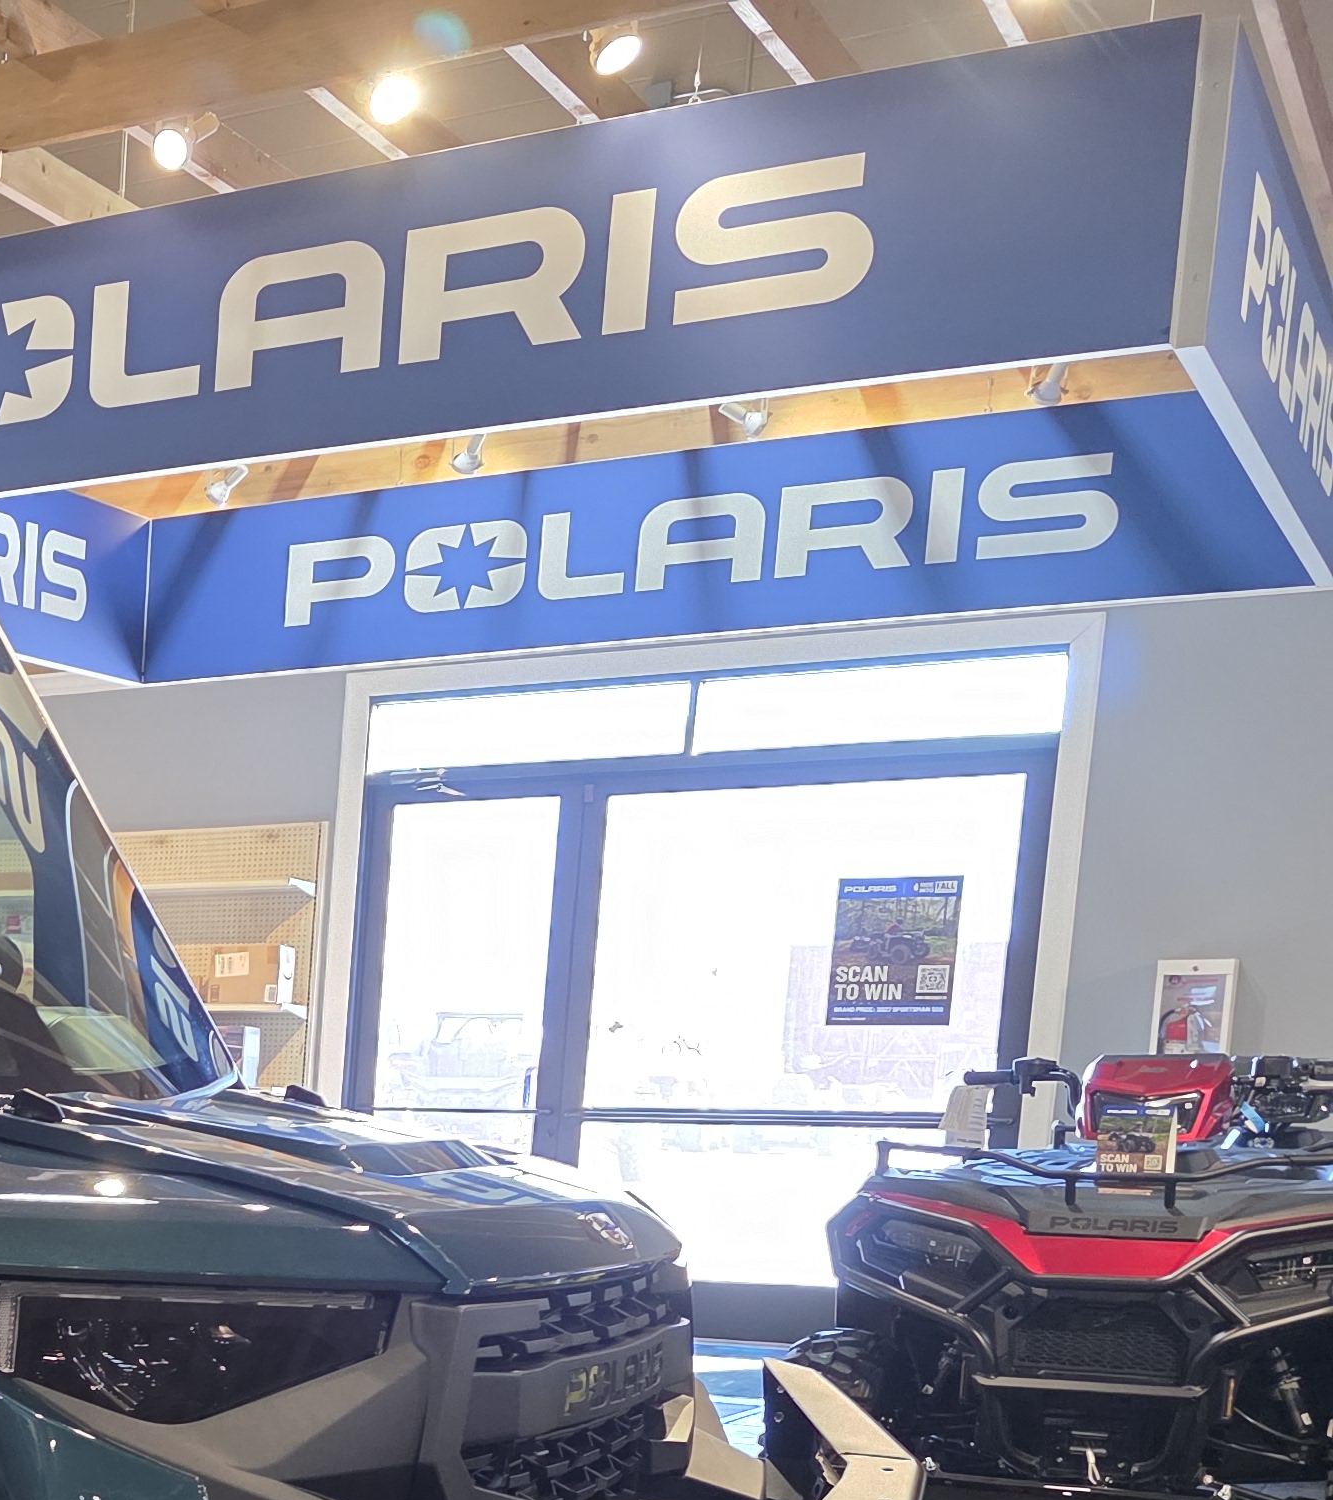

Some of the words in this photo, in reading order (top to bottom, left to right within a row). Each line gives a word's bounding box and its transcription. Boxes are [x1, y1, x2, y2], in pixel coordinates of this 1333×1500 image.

[284, 453, 1119, 627] POLARIS
[844, 885, 897, 893] POLARIS
[936, 881, 956, 890] FALL
[835, 965, 889, 982] SCAN
[834, 983, 859, 1001] TO
[864, 983, 903, 1001] WIN
[1099, 1153, 1130, 1164] SCAN
[1099, 1163, 1114, 1173] TO
[1115, 1163, 1138, 1174] WIN
[1049, 1215, 1179, 1234] POLARIS
[564, 1341, 663, 1416] POLARIS
